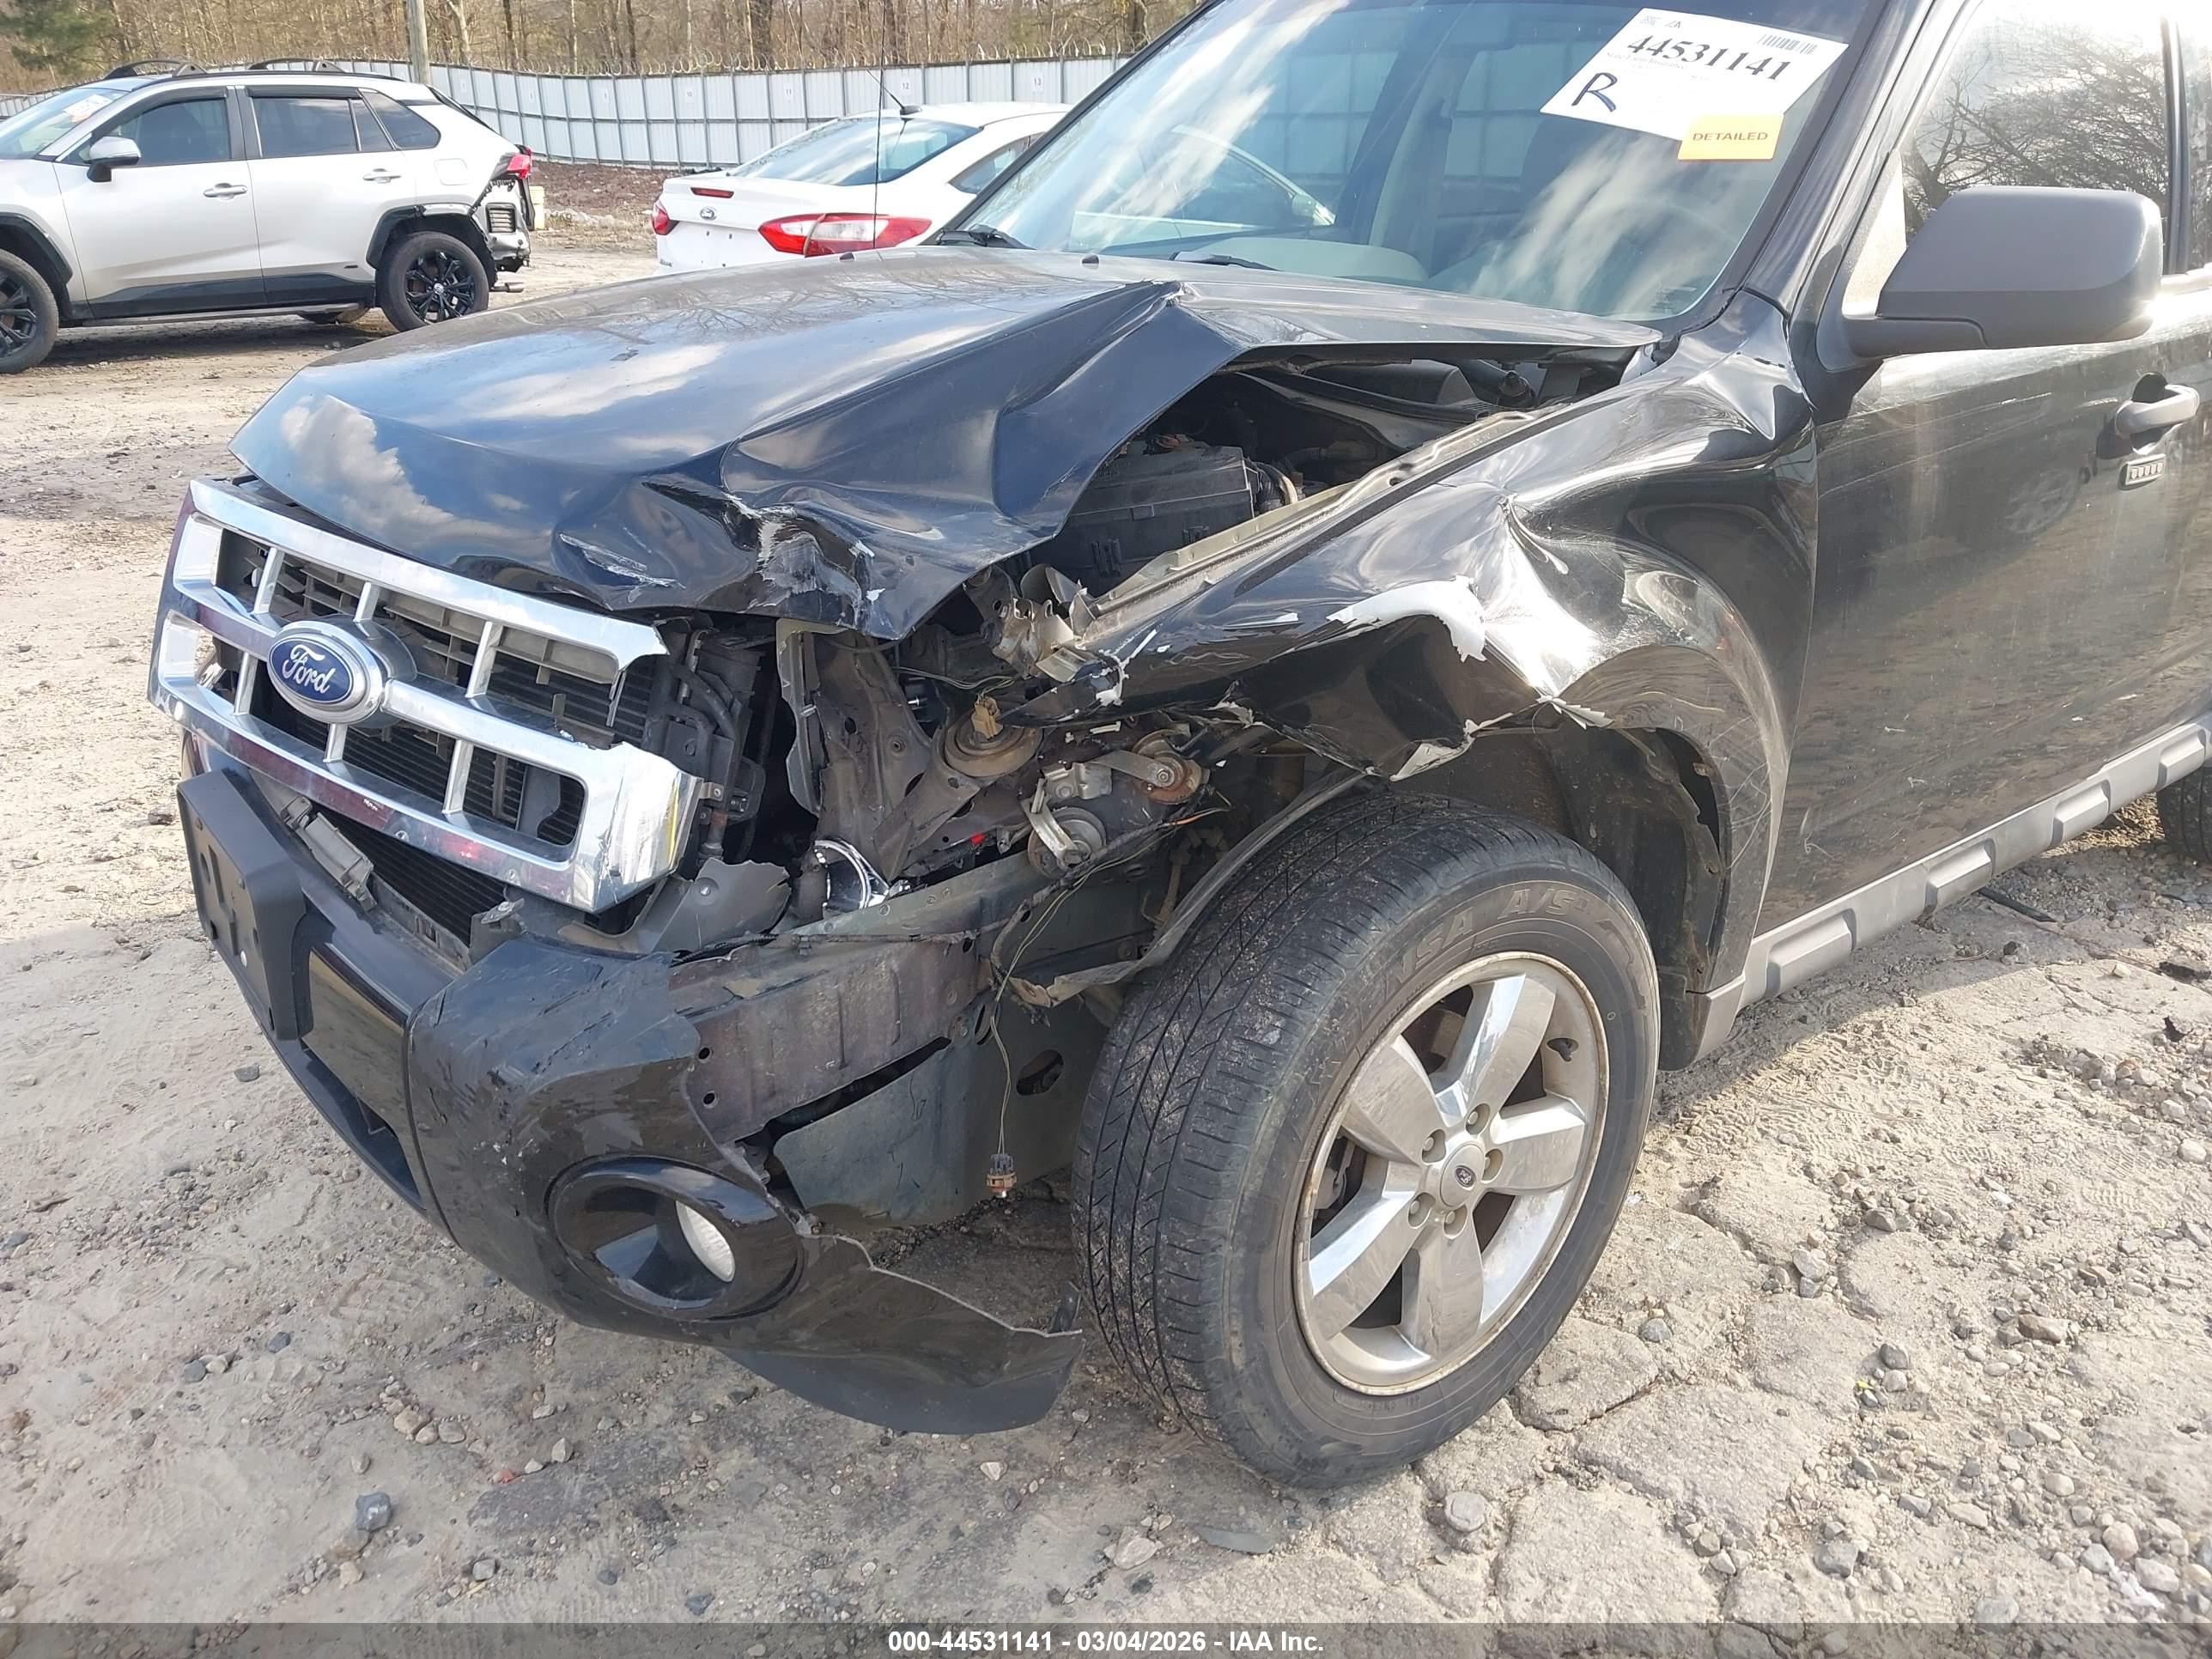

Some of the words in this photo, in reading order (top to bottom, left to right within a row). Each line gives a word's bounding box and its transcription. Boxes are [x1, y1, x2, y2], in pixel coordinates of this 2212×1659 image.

[1627, 35, 1791, 81] 44531141
[1571, 71, 1618, 112] R
[1692, 131, 1769, 142] DETAILED
[282, 644, 336, 694] Ford
